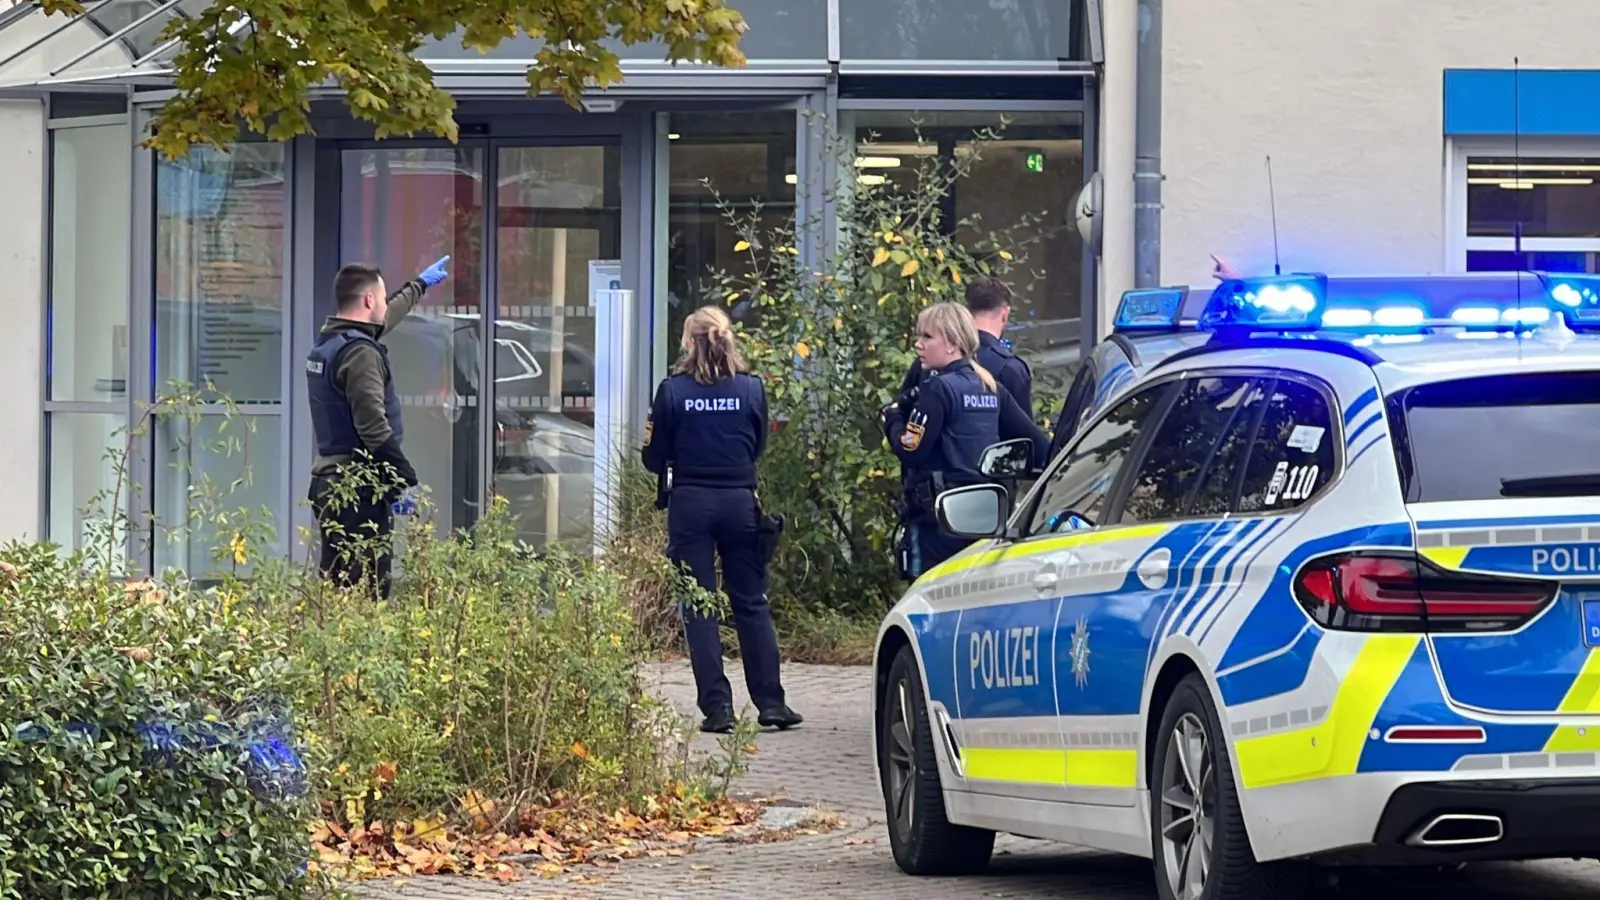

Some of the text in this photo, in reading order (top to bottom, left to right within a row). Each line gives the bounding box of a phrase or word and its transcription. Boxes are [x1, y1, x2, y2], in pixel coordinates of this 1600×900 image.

[684, 398, 740, 411] POLIZEI
[963, 394, 997, 408] POLIZEI
[1282, 464, 1319, 500] 110
[1532, 547, 1600, 572] POLI
[1591, 626, 1600, 638] D
[970, 625, 1039, 690] POLIZEI
